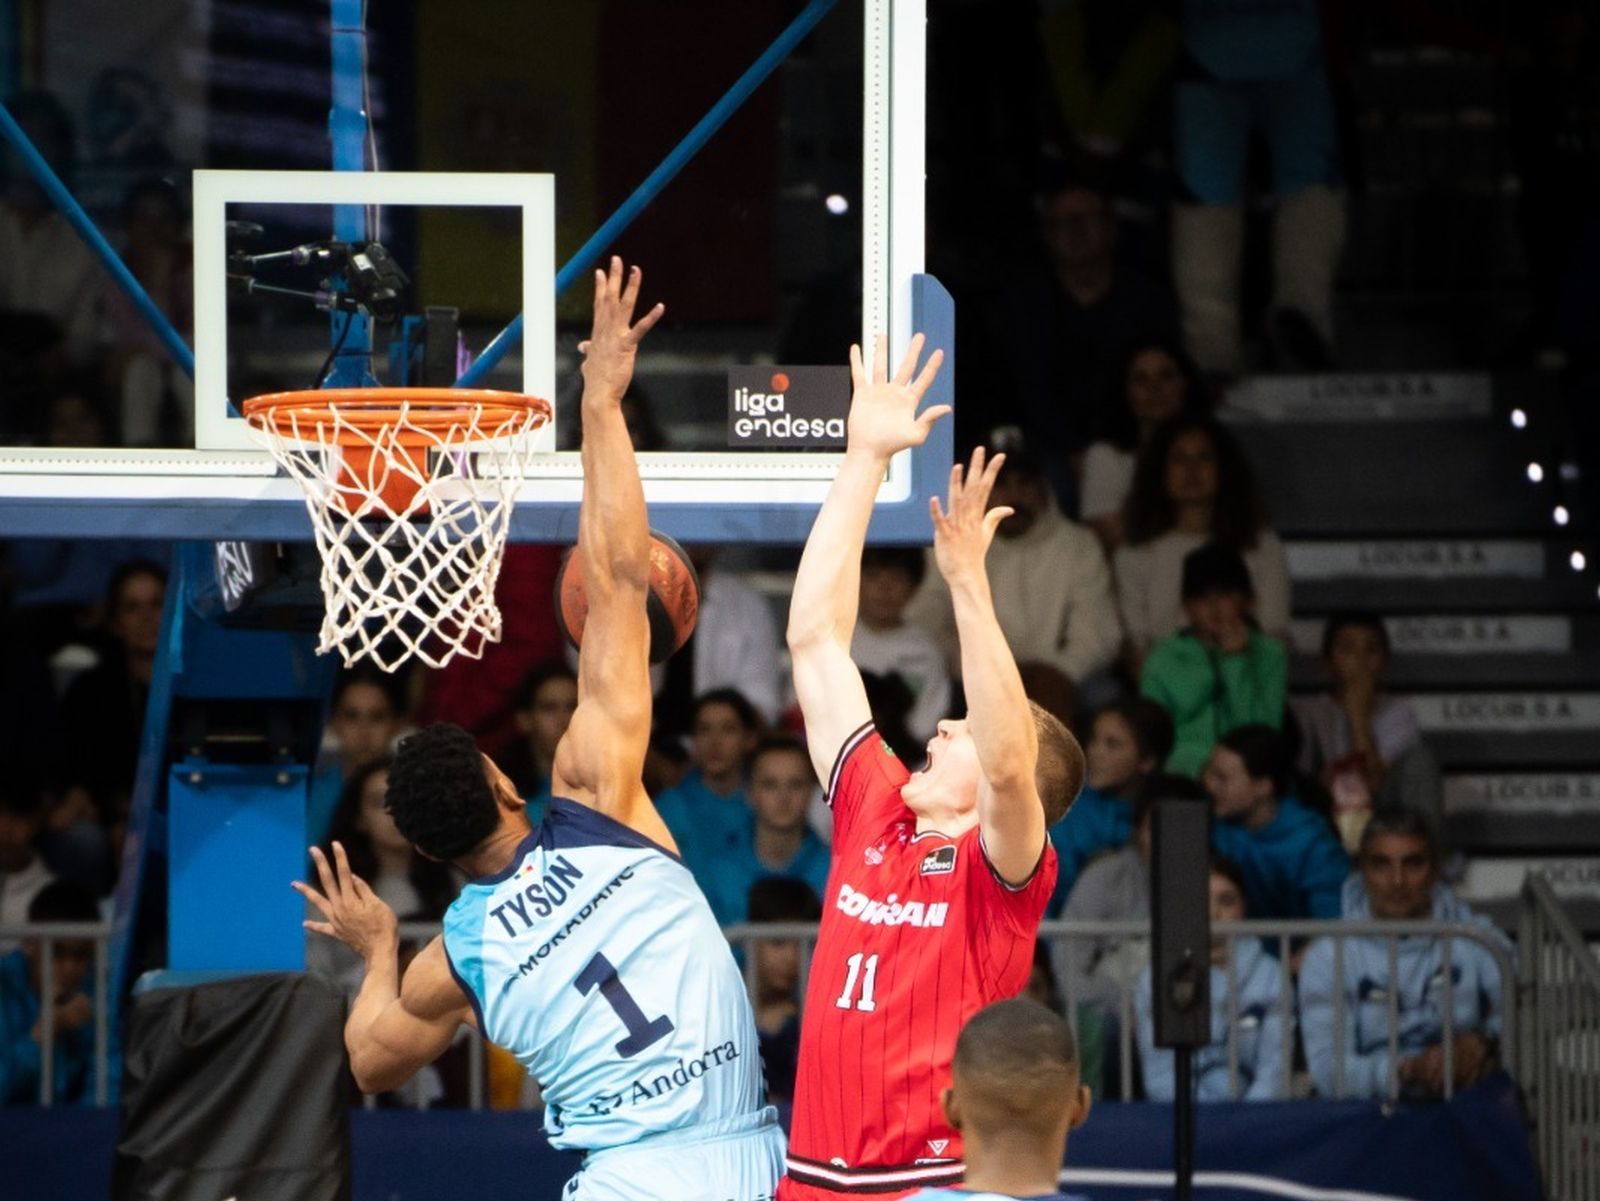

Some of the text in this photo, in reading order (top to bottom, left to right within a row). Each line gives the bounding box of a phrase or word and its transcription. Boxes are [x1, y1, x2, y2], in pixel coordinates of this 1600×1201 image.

[735, 386, 784, 416] liga
[735, 413, 844, 438] endesa
[489, 854, 583, 938] TYSON
[574, 951, 675, 1059] 1
[835, 953, 879, 1012] 11
[631, 1040, 741, 1105] Andorra
